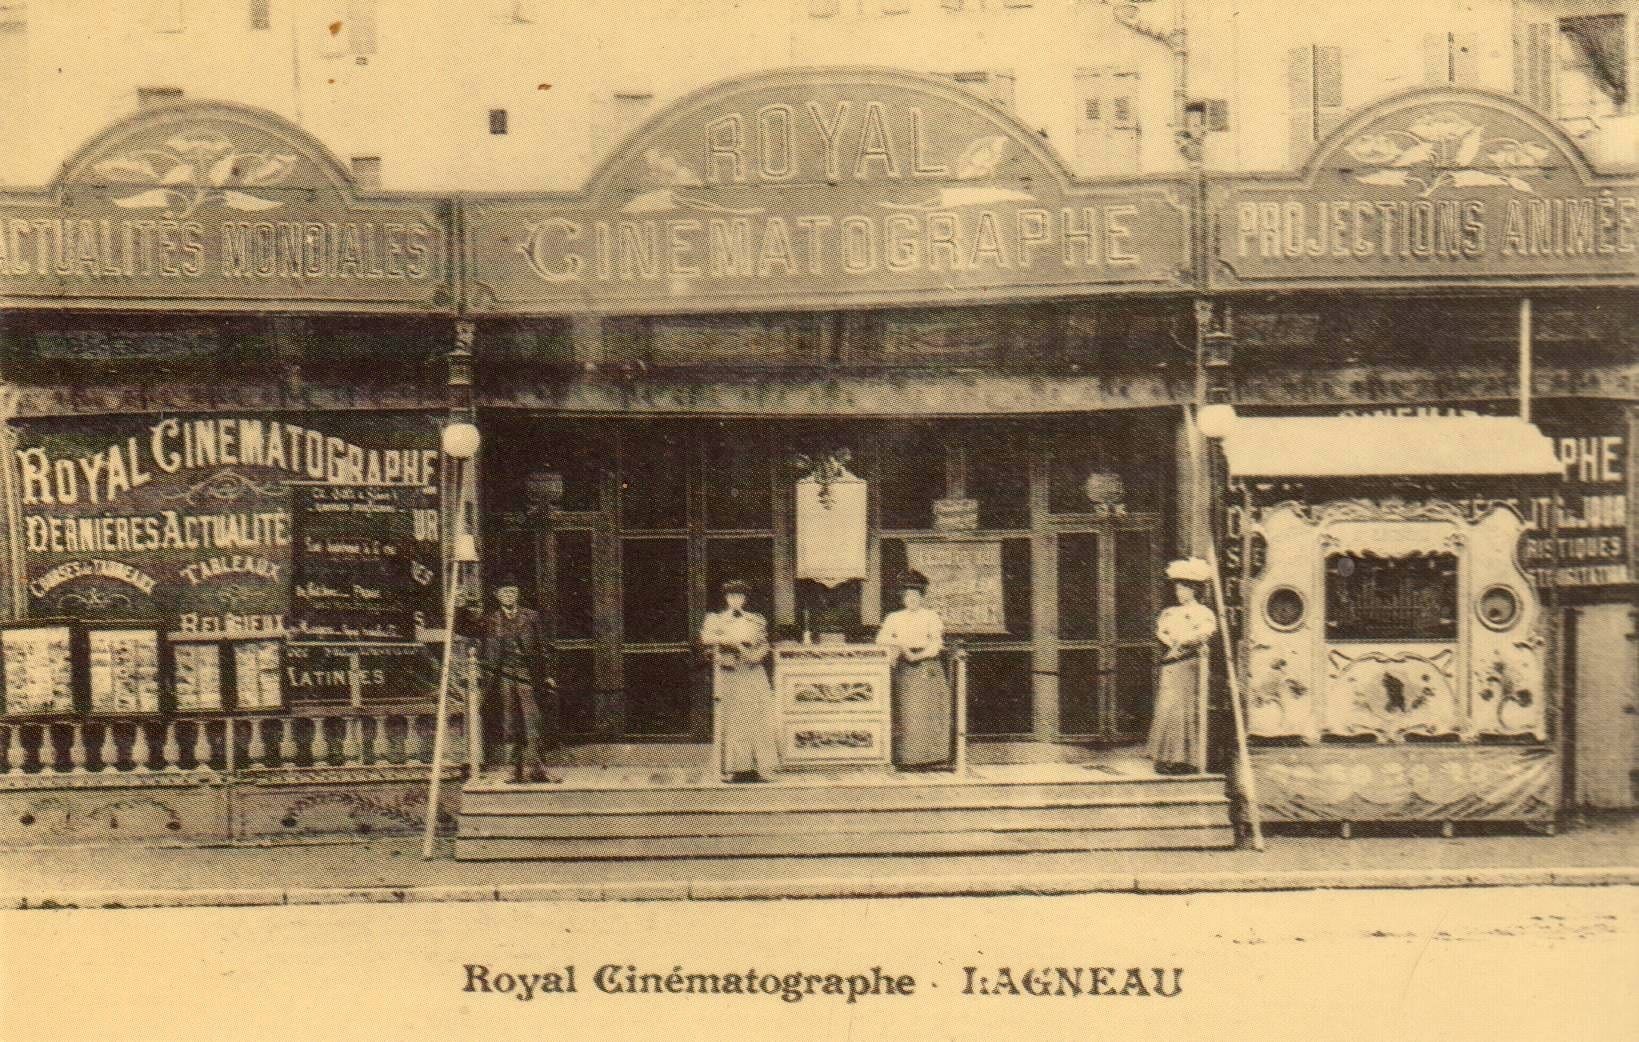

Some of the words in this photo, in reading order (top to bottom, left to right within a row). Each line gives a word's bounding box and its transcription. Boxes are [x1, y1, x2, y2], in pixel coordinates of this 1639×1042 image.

[706, 100, 950, 184] ROYAL
[222, 221, 428, 280] MONDIALES
[516, 204, 1141, 283] CINEMATOGRAPHE
[1237, 200, 1485, 258] PROJECTIONS
[17, 437, 151, 505] ROYAL
[149, 418, 438, 495] CINEMATOGRAPHE
[26, 512, 162, 552] DERNIÈRES
[160, 508, 291, 550] ACTUALITÉ
